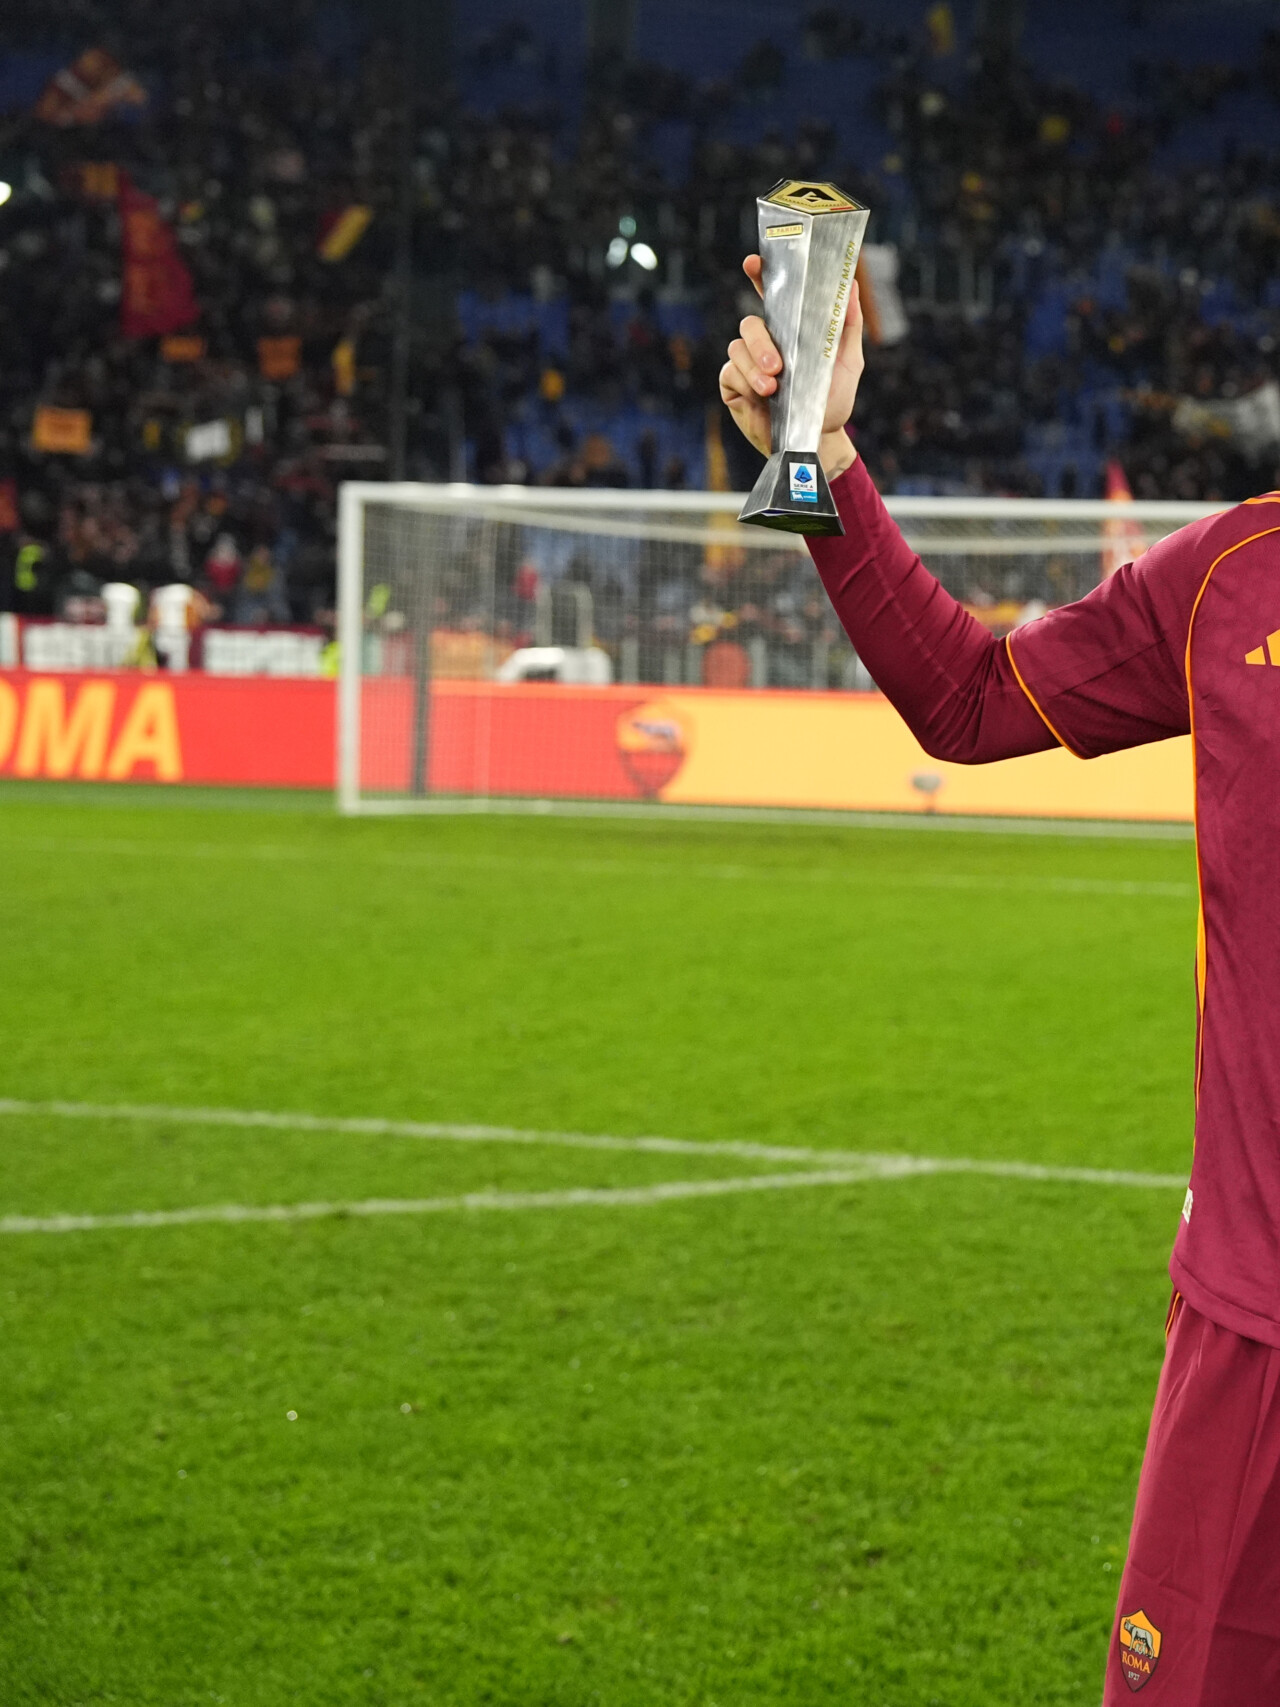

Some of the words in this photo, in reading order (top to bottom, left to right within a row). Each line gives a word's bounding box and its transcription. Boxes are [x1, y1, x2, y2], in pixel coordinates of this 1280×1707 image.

[776, 225, 801, 233] PANINI
[842, 240, 856, 280] MATCH
[836, 281, 848, 300] THE
[833, 302, 842, 318] OF
[823, 319, 839, 359] PLAYER
[1122, 1651, 1151, 1674] ROMA
